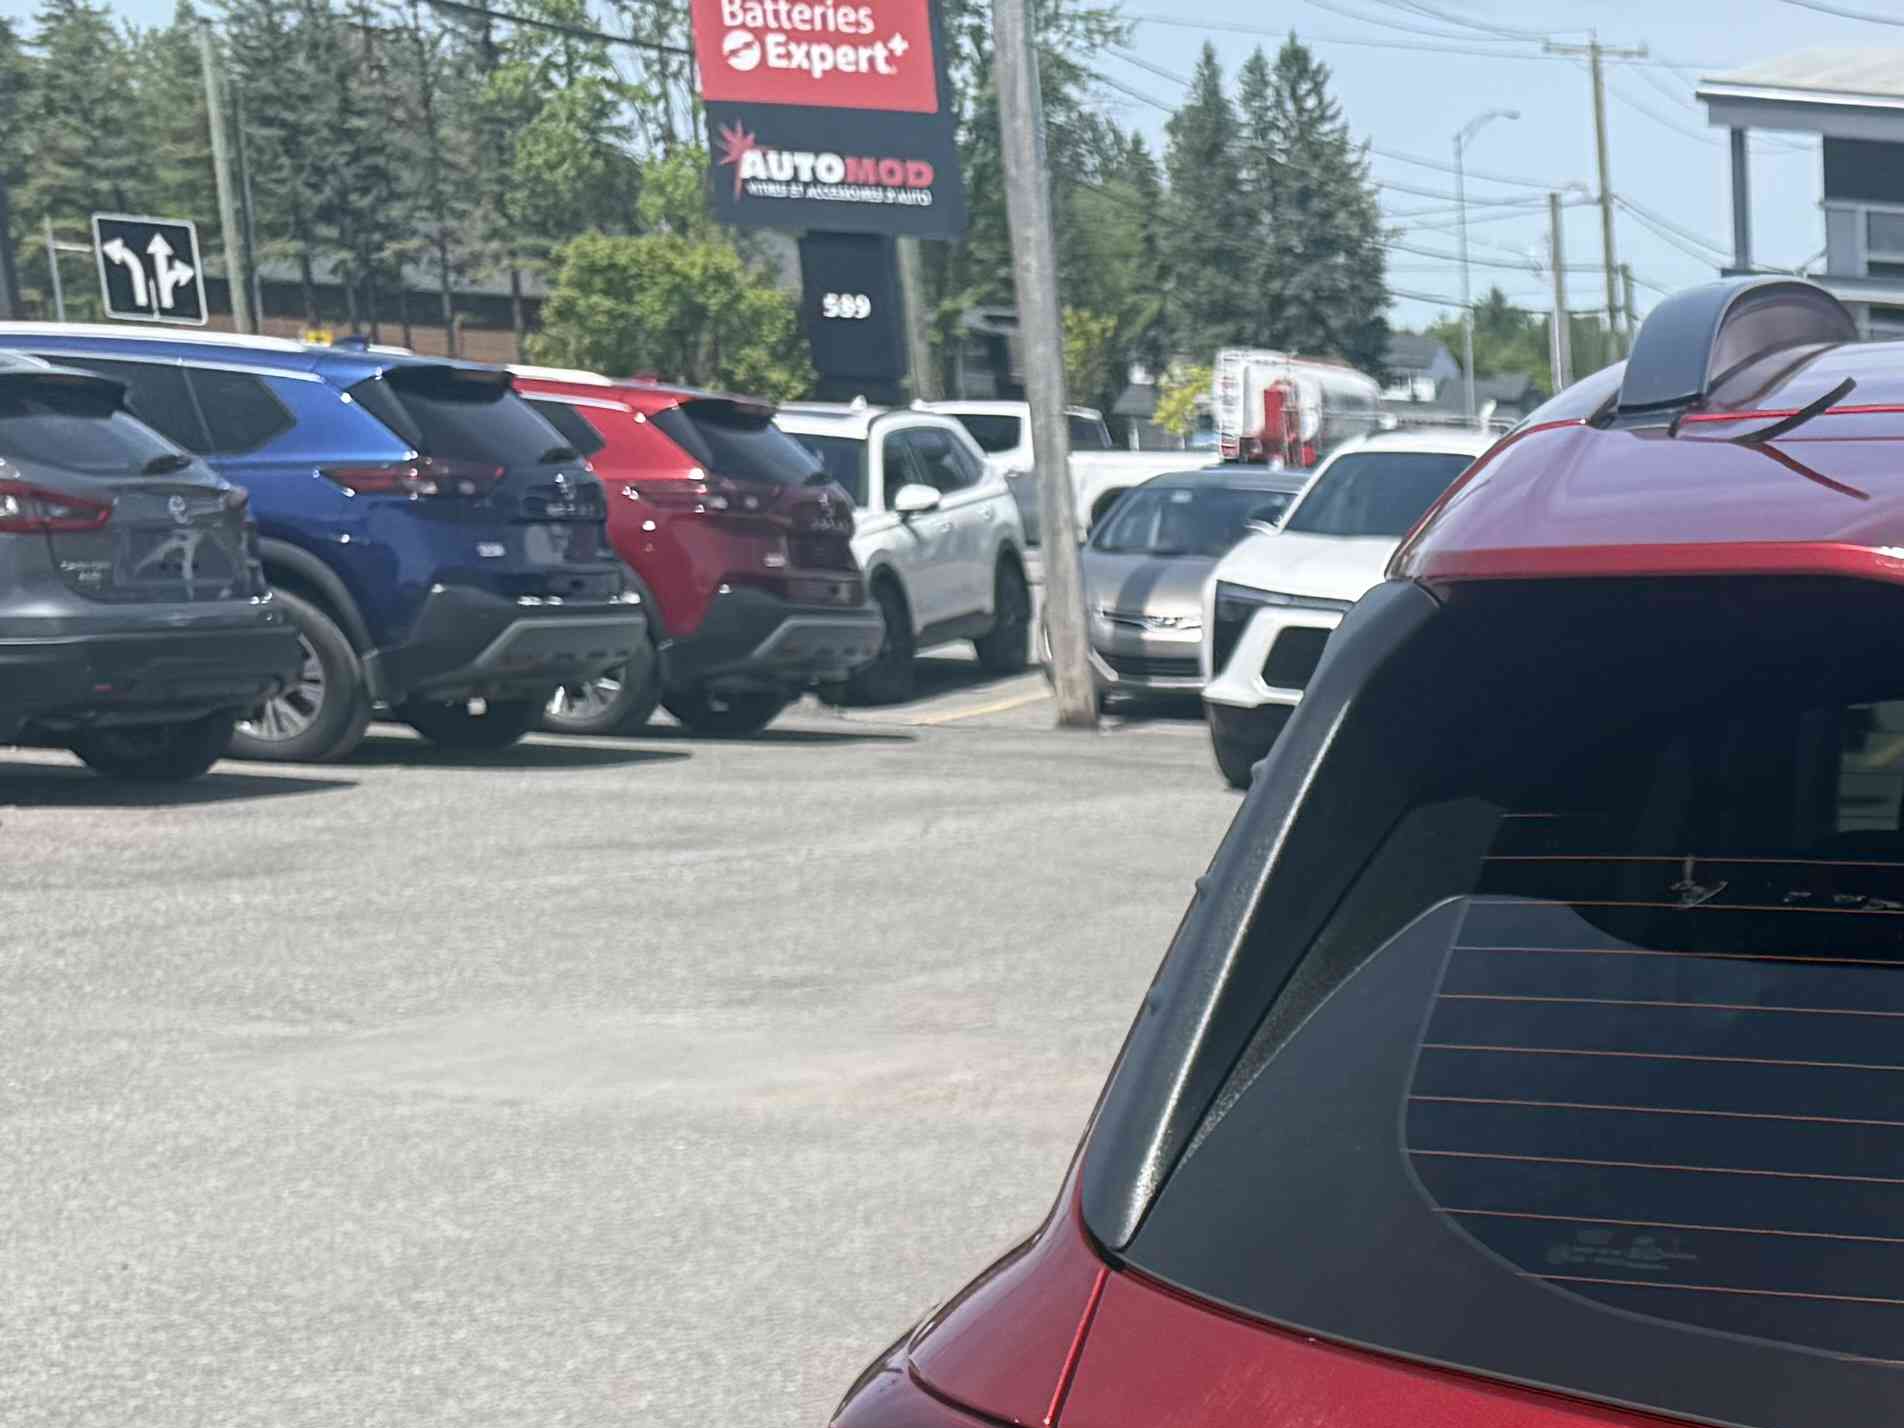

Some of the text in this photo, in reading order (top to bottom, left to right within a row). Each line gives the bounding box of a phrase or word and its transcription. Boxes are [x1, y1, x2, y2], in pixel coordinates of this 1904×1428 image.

[721, 0, 875, 34] Batteries
[740, 150, 935, 189] AUTOMOD
[823, 292, 871, 319] 589
